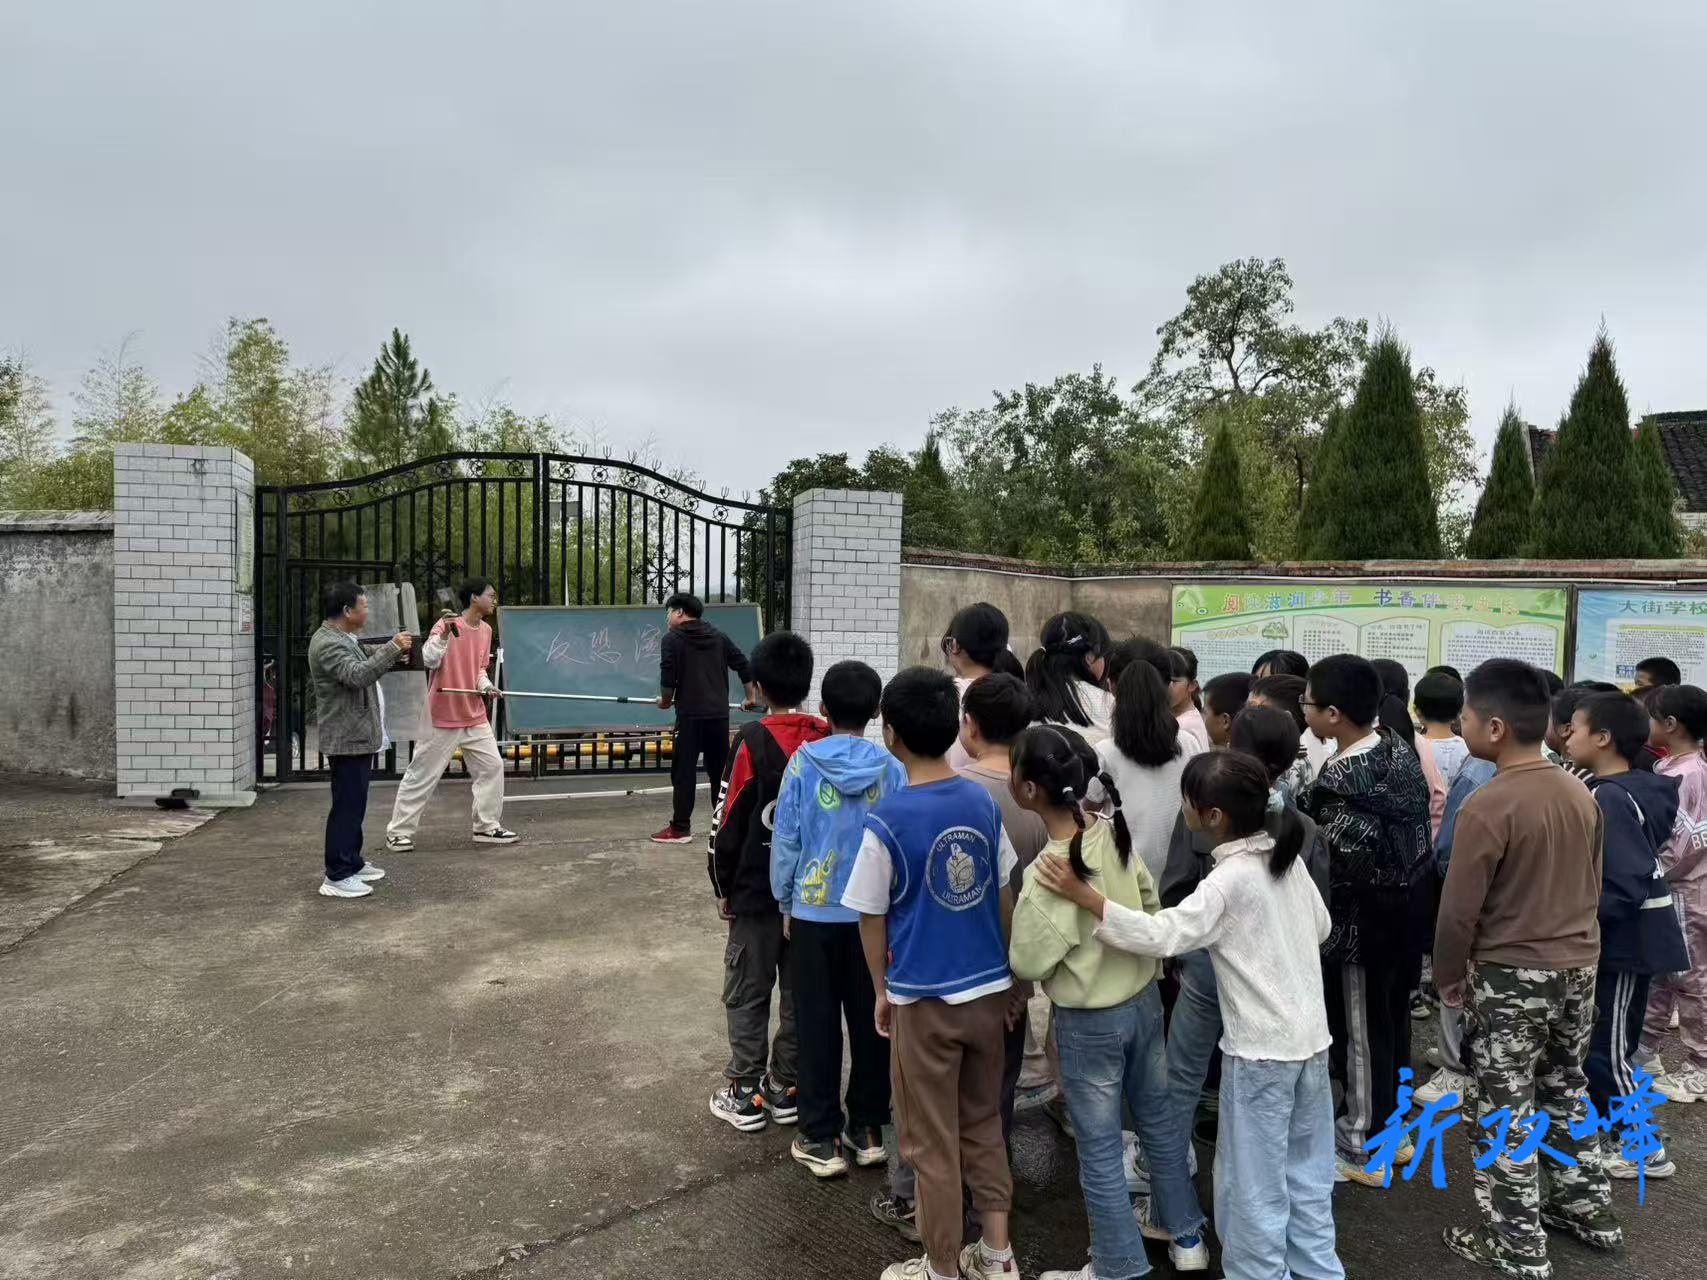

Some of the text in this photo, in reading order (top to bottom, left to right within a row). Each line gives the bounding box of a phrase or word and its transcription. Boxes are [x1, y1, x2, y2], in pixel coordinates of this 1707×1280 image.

[1617, 599, 1707, 615] 大街学校
[936, 832, 976, 852] ULTRAMAN
[942, 884, 982, 904] ULTRAMAN
